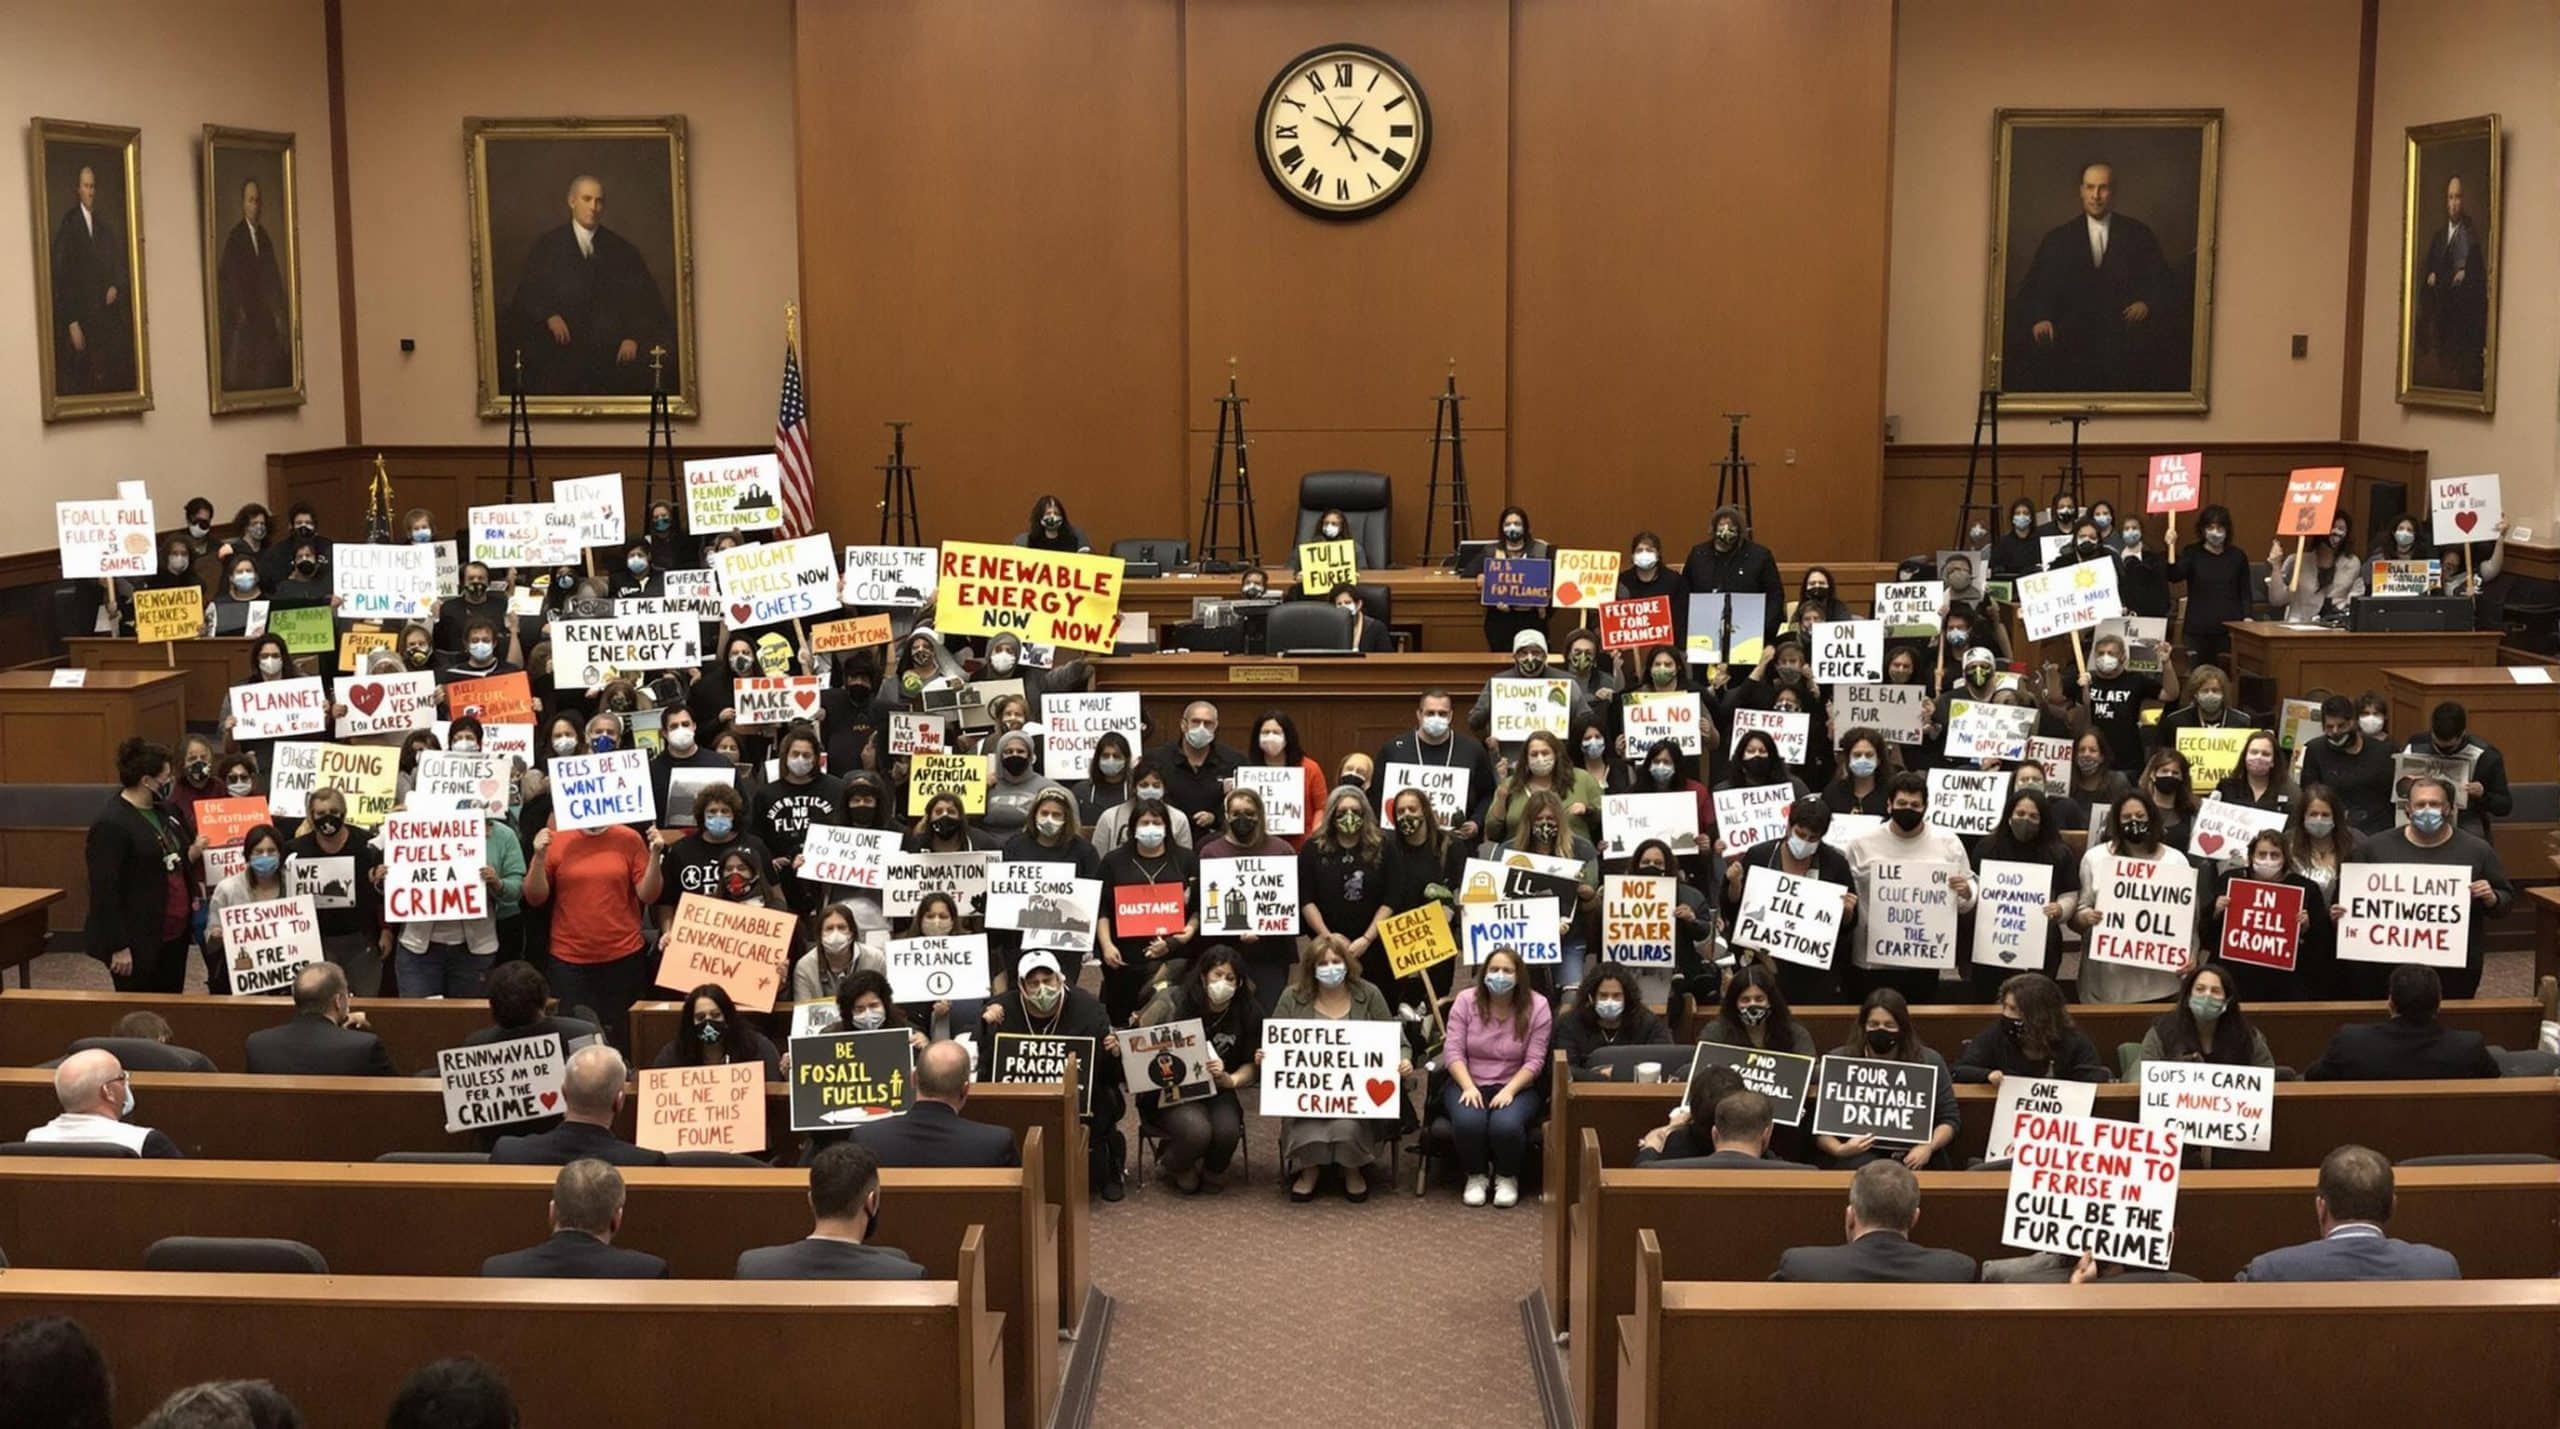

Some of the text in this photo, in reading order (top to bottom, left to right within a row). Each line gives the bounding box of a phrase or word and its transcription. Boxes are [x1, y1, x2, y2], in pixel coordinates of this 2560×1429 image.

[118, 509, 148, 525] FULL
[903, 551, 925, 566] THE
[1307, 544, 1350, 567] TULL
[798, 567, 829, 586] NOW
[942, 552, 1112, 597] RENEWABLE
[857, 584, 888, 601] COL
[958, 584, 1084, 617] ENERGY
[982, 609, 1031, 630] NOW
[566, 623, 681, 642] RENEWABLE
[1051, 614, 1124, 648] NOW!
[1834, 625, 1854, 639] ON
[1824, 643, 1866, 659] CALL
[242, 691, 320, 713] PLANNET
[740, 691, 790, 714] MAKE
[372, 715, 413, 730] CARES
[1667, 707, 1692, 722] NO
[321, 751, 383, 776] FOUNG
[558, 756, 616, 777] FELS BE
[562, 777, 626, 796] WANT A
[1421, 772, 1453, 788] COM
[388, 819, 479, 841] RENEWABLE
[828, 829, 881, 849] YOU ONE
[393, 844, 451, 864] FUELS
[296, 865, 318, 878] WE
[412, 867, 457, 883] ARE A
[815, 862, 878, 886] CRIME
[1009, 865, 1043, 879] FREE
[1251, 874, 1284, 887] CANE
[1879, 865, 1901, 880] LLE
[991, 880, 1028, 895] LEALE
[1777, 876, 1800, 896] DE
[2368, 873, 2461, 896] OLL LANT
[389, 884, 482, 917] CRIME
[1253, 890, 1277, 902] AND
[2253, 888, 2277, 909] IN
[225, 910, 249, 925] FEE
[1609, 902, 1669, 919] LLOVE
[1887, 907, 1923, 925] BUDE
[1258, 918, 1289, 932] FANE
[2106, 910, 2175, 937] IN OLL
[2241, 909, 2286, 933] FELL
[1608, 922, 1671, 942] STAER
[2369, 925, 2450, 951] CRIME
[923, 939, 948, 949] ONE
[256, 947, 285, 965] FRE
[690, 952, 741, 978] ENEW
[835, 1042, 855, 1059] BE
[1019, 1041, 1066, 1057] FRASE
[1284, 1051, 1383, 1068] FAUREL IN
[650, 1067, 751, 1089] BE EALL DO
[800, 1063, 871, 1084] FOSAIL
[1274, 1072, 1354, 1091] FEADE A
[1848, 1065, 1907, 1086] FOUR A
[2212, 1072, 2261, 1091] CARN
[466, 1084, 532, 1101] FER A THE
[656, 1087, 749, 1108] OIL NE OF
[2147, 1092, 2169, 1107] LIE
[705, 1105, 740, 1121] THIS
[1842, 1105, 1914, 1130] DRIME
[678, 1126, 734, 1146] FOUME
[2014, 1112, 2178, 1158] FOAIL FUELS
[2144, 1158, 2175, 1182] TO
[2032, 1170, 2142, 1202] FRRISE IN
[2015, 1192, 2163, 1232] CULL BE THE
[2014, 1217, 2060, 1246] FUR
